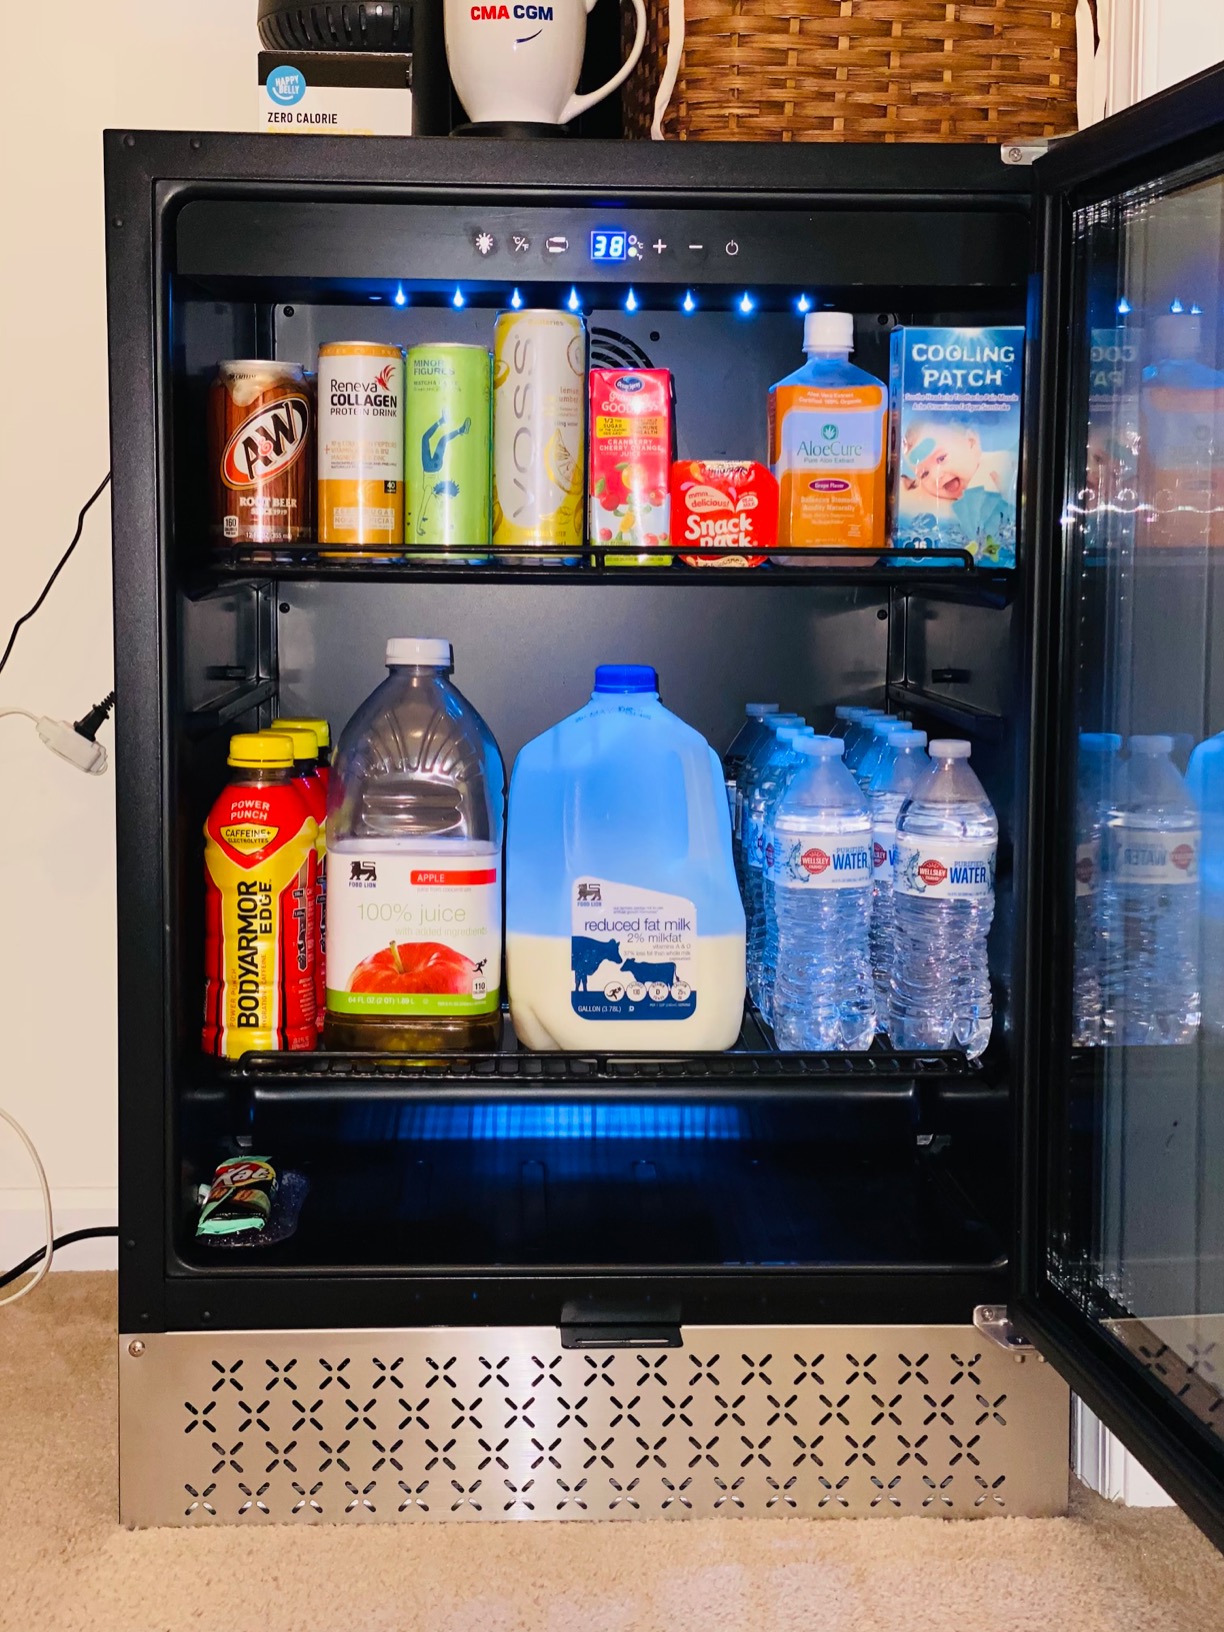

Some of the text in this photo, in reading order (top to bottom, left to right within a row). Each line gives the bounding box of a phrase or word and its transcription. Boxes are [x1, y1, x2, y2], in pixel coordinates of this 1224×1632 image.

[470, 5, 553, 21] CMA CGM
[275, 75, 299, 86] HAPPY
[278, 85, 299, 95] BELLY
[267, 112, 338, 124] ZERO CALORIE
[593, 235, 624, 257] 38
[912, 344, 1015, 363] COOLING
[413, 359, 445, 367] MINOR
[413, 367, 455, 376] FIGURES
[923, 369, 1003, 388] PATCH
[330, 378, 378, 393] Reneva
[330, 393, 397, 409] COLLAGEN
[601, 400, 658, 414] GOODESS
[372, 408, 397, 417] DRINK
[242, 400, 299, 481] A&W
[796, 440, 863, 457] AloeCure
[239, 497, 297, 508] ROOT BEER
[691, 500, 730, 508] delicious!
[225, 518, 237, 526] 160
[684, 513, 754, 540] Snack
[230, 799, 271, 811] POWER
[230, 809, 268, 821] PUNCH
[802, 857, 830, 865] WELLSLEY
[832, 852, 868, 870] WATER
[417, 873, 445, 883] APPLE
[919, 867, 947, 877] WELLSLEY
[950, 867, 986, 884] WATER
[258, 881, 273, 934] EDGE
[357, 902, 466, 925] 100% juice
[584, 918, 691, 932] reduced fat milk
[627, 933, 682, 943] 2% milkfat
[237, 880, 259, 1029] BODYARMOR
[474, 982, 486, 990] 110
